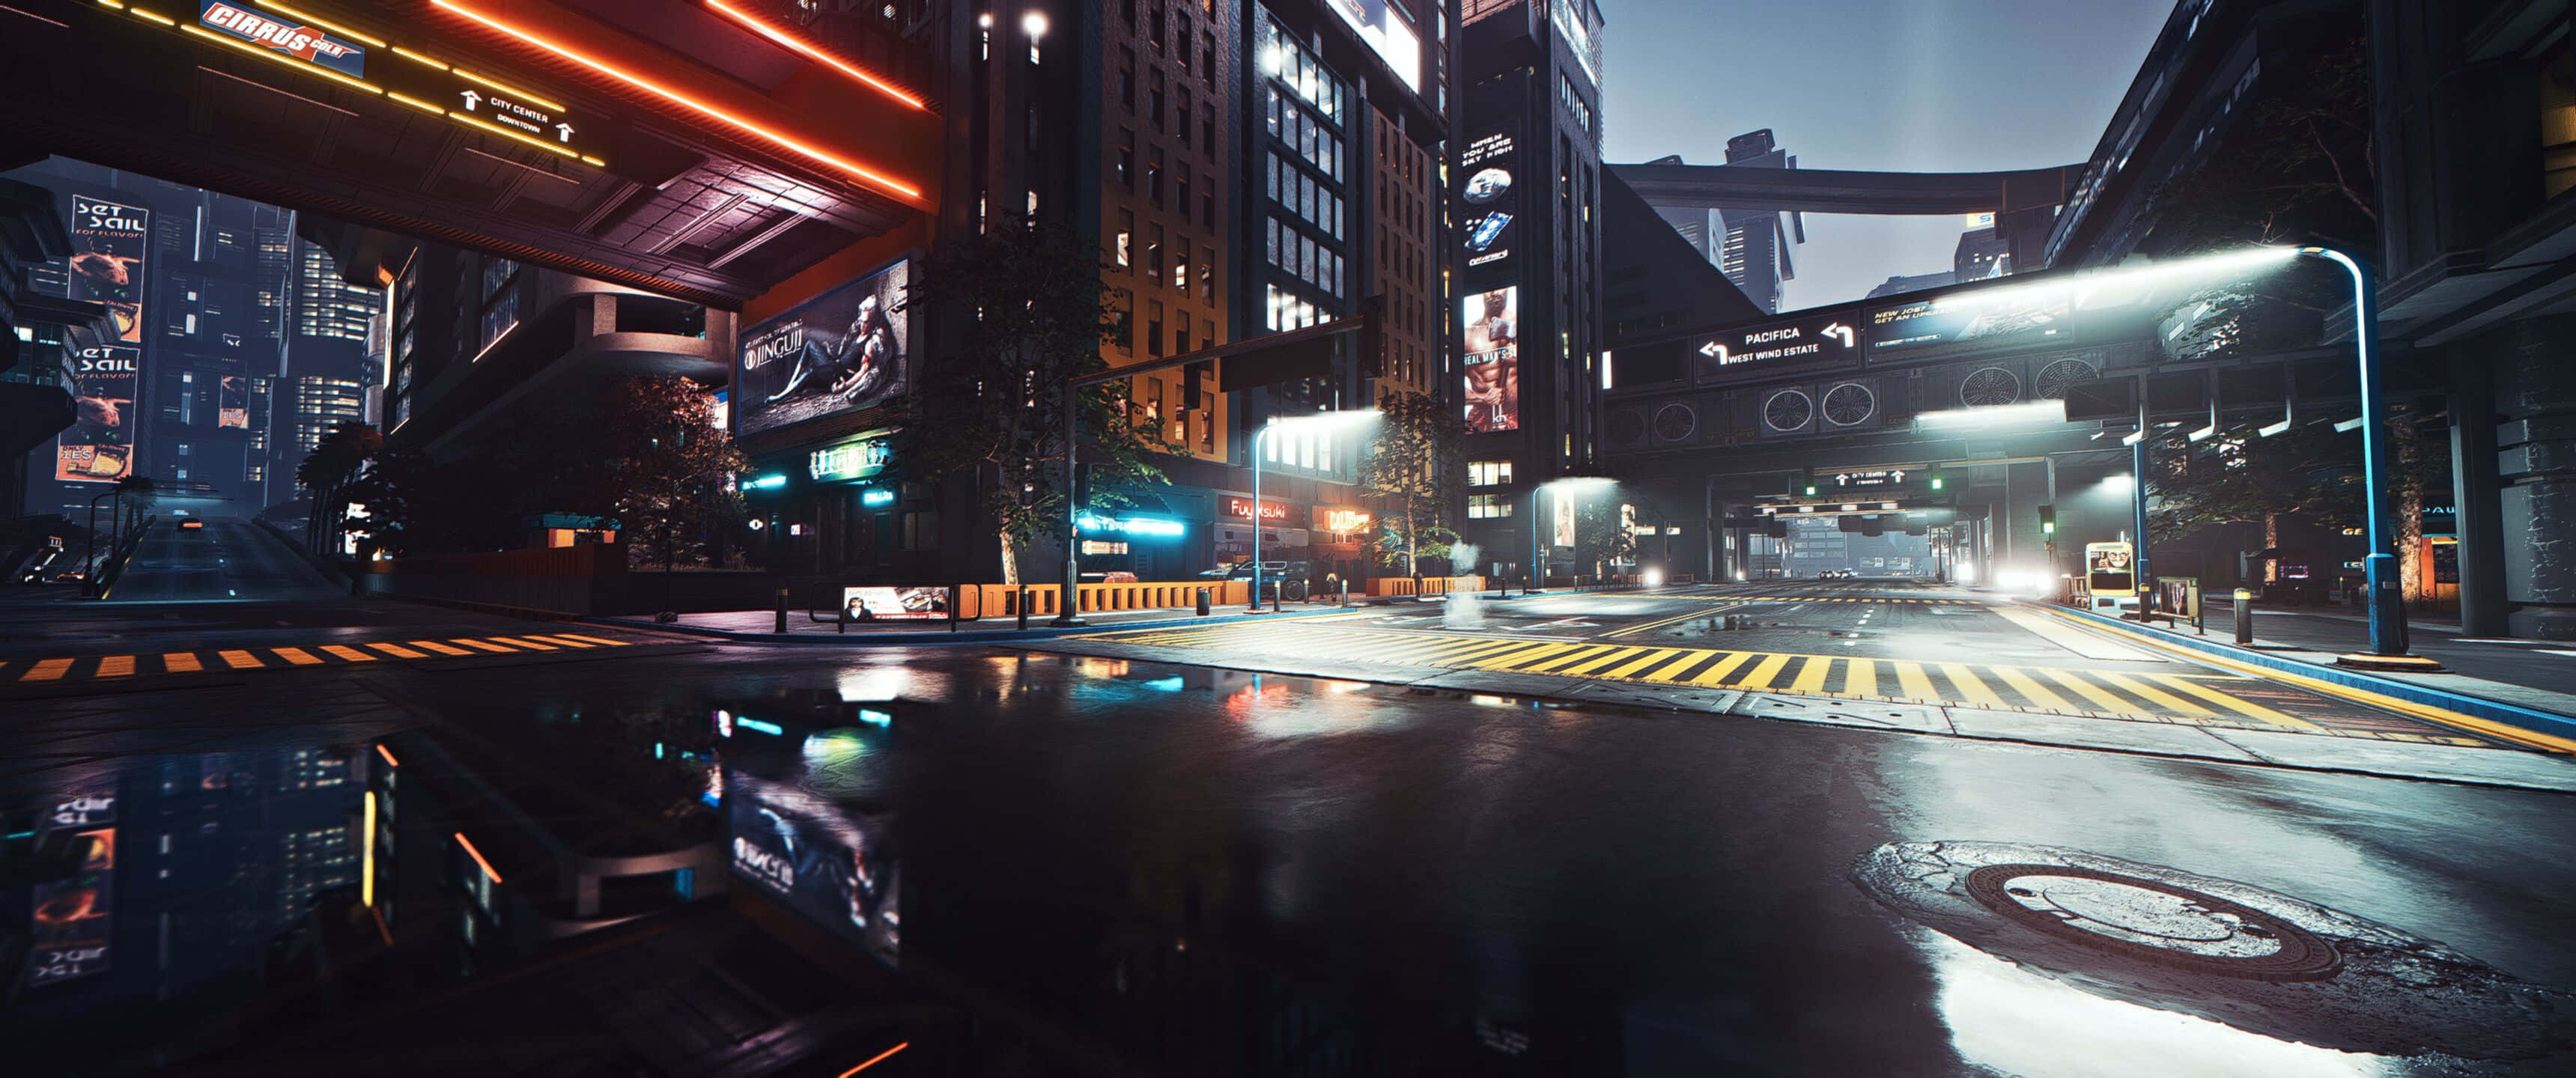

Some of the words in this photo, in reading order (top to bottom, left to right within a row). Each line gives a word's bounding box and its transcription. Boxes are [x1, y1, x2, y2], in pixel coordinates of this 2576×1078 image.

[207, 6, 312, 51] CIRRUS
[309, 39, 344, 56] COLA
[490, 97, 512, 110] CITY
[513, 105, 548, 124] CENTER
[497, 113, 541, 133] DOWNTOWN
[1462, 147, 1485, 160] YOU
[1488, 138, 1511, 150] ARE
[1471, 133, 1502, 149] WHEN
[1462, 155, 1481, 168] SKY
[1874, 309, 1900, 320] NEW
[1901, 305, 1927, 314] JOB?
[1874, 315, 1892, 324] GET
[1895, 313, 1910, 322] AN
[1746, 327, 1800, 345] PACIFICA
[755, 329, 803, 368] JINGUJI
[1728, 353, 1755, 364] WEST
[1755, 348, 1781, 361] WIND
[1784, 343, 1820, 357] ESTATE
